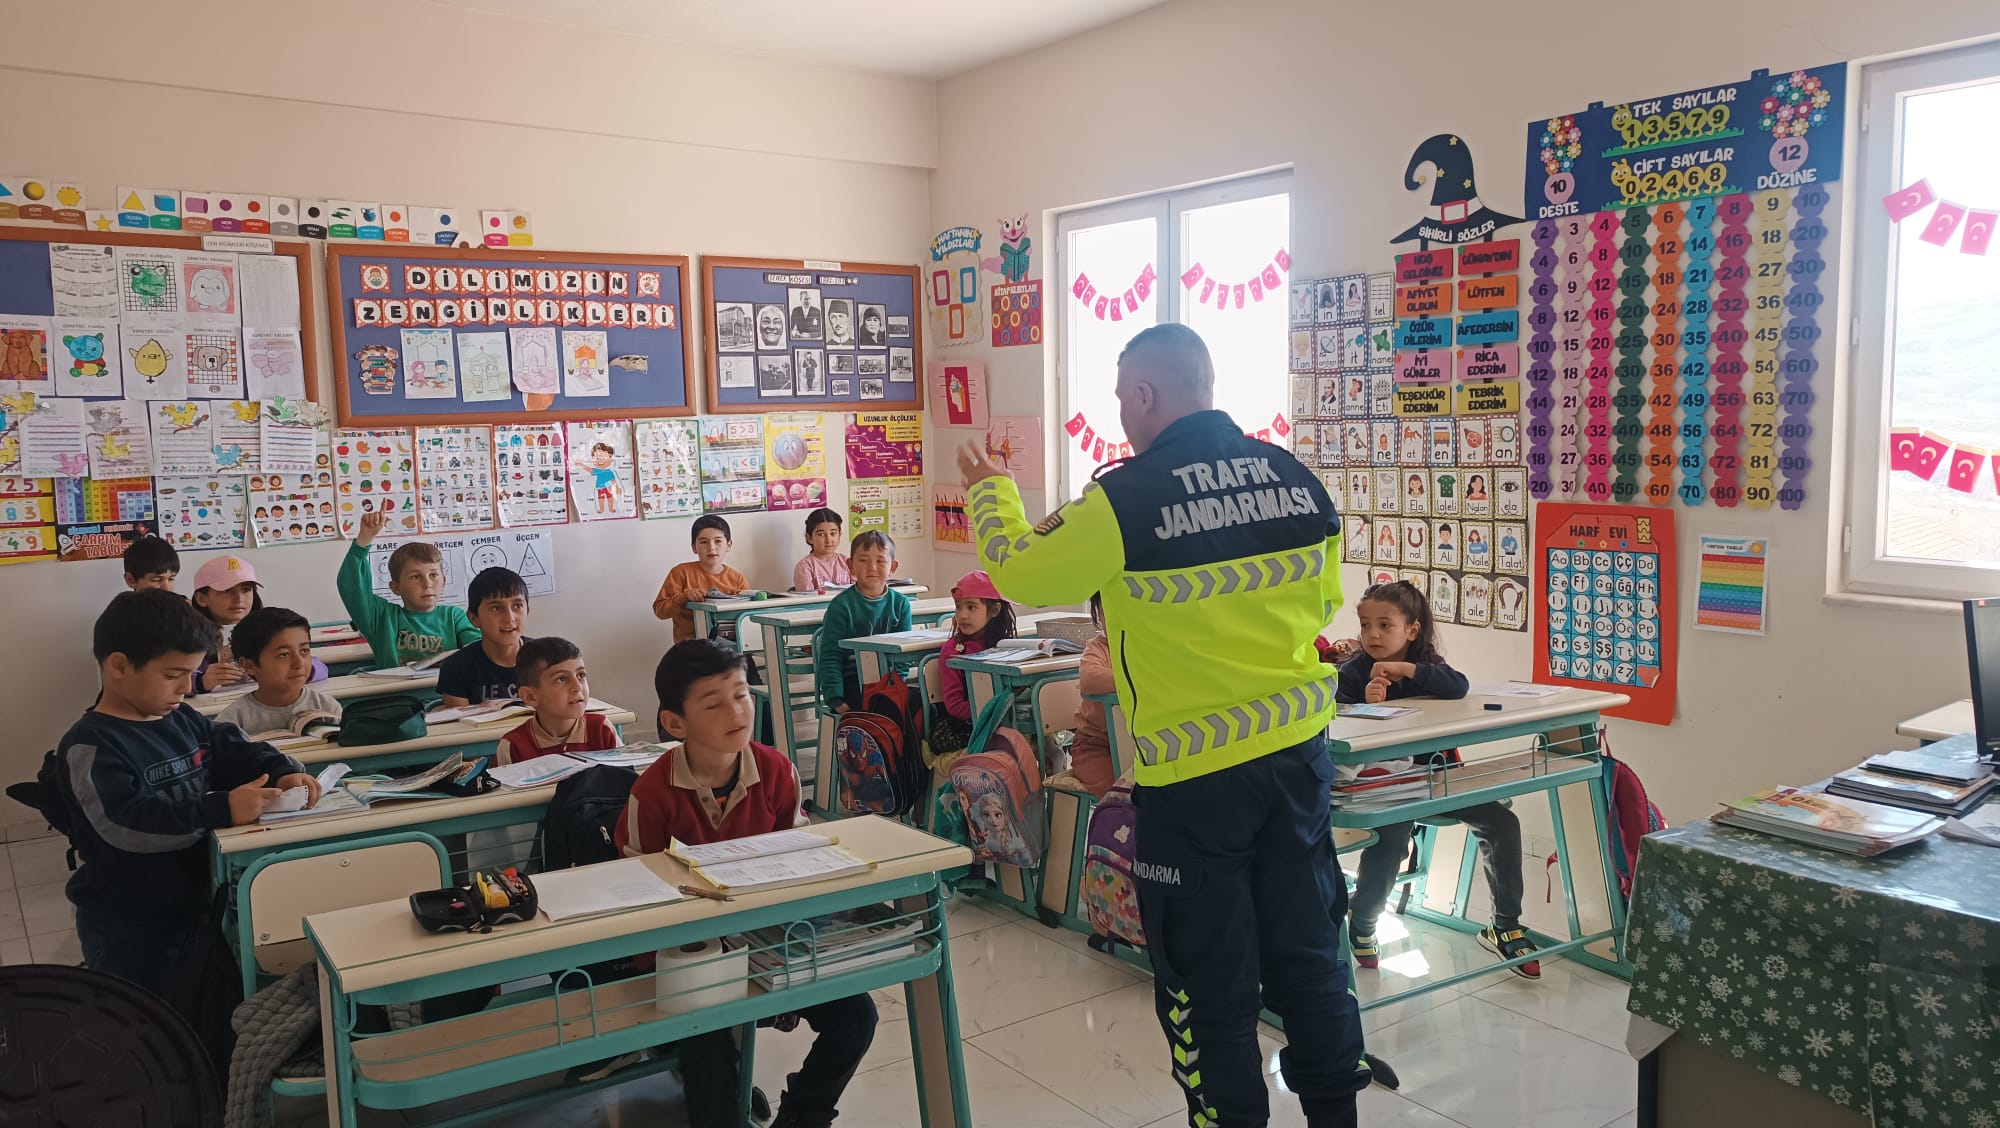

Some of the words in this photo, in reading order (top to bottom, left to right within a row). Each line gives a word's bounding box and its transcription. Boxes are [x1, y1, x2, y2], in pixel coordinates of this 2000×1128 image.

[1633, 101, 1661, 117] TEK
[1672, 88, 1737, 110] SAYILAR
[1627, 124, 1635, 137] 1
[1648, 120, 1658, 134] 3
[1669, 116, 1680, 130] 5
[1692, 113, 1702, 127] 7
[1713, 109, 1724, 124] 9
[1778, 144, 1801, 162] 12
[1633, 157, 1666, 178] ÇİFT
[1671, 148, 1734, 169] SAYILAR
[1626, 181, 1636, 194] 0
[1646, 177, 1656, 192] 2
[1667, 175, 1678, 188] 4
[1689, 171, 1698, 185] 6
[1710, 168, 1721, 182] 8
[1757, 168, 1817, 190] DÜZİNE
[1550, 180, 1567, 194] 10
[1539, 201, 1579, 218] DESTE
[1540, 227, 1548, 239] 2
[1570, 223, 1578, 235] 3
[1600, 219, 1609, 231] 4
[1631, 215, 1640, 227] 5
[1664, 211, 1673, 223] 6
[1696, 205, 1706, 219] 7
[1729, 202, 1740, 215] 8
[1767, 198, 1779, 211] 9
[1803, 193, 1820, 207] 10
[1418, 226, 1452, 242] SİHİRLİ
[1457, 220, 1495, 241] SÖZLER
[412, 269, 623, 290] DİLİMİZİN
[1407, 287, 1439, 299] AFİYET
[1468, 286, 1505, 298] LÜTFEN
[363, 302, 668, 322] ZENGİNLİKLERİ
[1375, 303, 1385, 316] tel
[1407, 301, 1438, 312] OLSUN
[1538, 313, 1546, 324] 8
[1563, 310, 1579, 322] 12
[1593, 308, 1608, 320] 16
[1622, 305, 1643, 318] 20
[1657, 303, 1676, 316] 24
[1686, 300, 1707, 314] 28
[1720, 298, 1742, 311] 32
[1756, 295, 1780, 309] 36
[1790, 293, 1816, 306] 40
[1323, 310, 1333, 320] in
[1409, 321, 1434, 333] ÖZÜR
[1458, 320, 1513, 336] AFEDERSİN
[1404, 334, 1442, 345] DİLERİM
[1351, 351, 1358, 364] it
[1475, 351, 1499, 362] RİCA
[1404, 367, 1440, 378] GÜNLER
[1468, 363, 1506, 376] EDERİM
[1532, 369, 1548, 381] 12
[1563, 368, 1578, 379] 18
[1591, 367, 1608, 379] 24
[1621, 365, 1640, 377] 30
[1654, 364, 1673, 376] 36
[1683, 363, 1704, 376] 42
[1717, 362, 1740, 375] 48
[1755, 360, 1774, 374] 54
[1786, 359, 1810, 373] 60
[1397, 388, 1445, 402] TEŞEKKÜR
[1468, 385, 1504, 398] TEBRİK
[1298, 403, 1305, 414] el
[1320, 404, 1337, 415] Ata
[1346, 403, 1364, 412] anne
[1376, 400, 1389, 412] Eti
[1403, 402, 1438, 413] EDERİM
[1468, 397, 1506, 411] EDERİM
[864, 415, 888, 423] UZUNLUK
[890, 414, 917, 424] ÖLÇÜLERİ
[1323, 452, 1340, 460] nine
[1377, 451, 1391, 460] ne
[1407, 450, 1416, 458] at
[1435, 451, 1449, 460] en
[1467, 451, 1476, 460] et
[1495, 449, 1512, 459] an
[1172, 457, 1280, 495] TRAFİK
[5, 479, 17, 491] 2
[24, 478, 33, 491] 5
[1381, 497, 1394, 510] ele
[1410, 500, 1423, 511] Ela
[1436, 499, 1457, 511] laleli
[1467, 502, 1488, 512] Nalan
[1504, 500, 1517, 511] ela
[6, 507, 17, 520] 8
[25, 506, 37, 520] 3
[1154, 487, 1319, 540] JANDARMASI
[516, 533, 540, 542] ÜÇGEN
[1570, 526, 1600, 538] HARF
[1609, 525, 1627, 539] EVİ
[8, 537, 19, 550] 4
[26, 536, 37, 550] 9
[72, 533, 122, 551] ÇARPIM
[471, 535, 501, 546] ÇEMBER
[376, 543, 398, 551] KARE
[1350, 548, 1367, 558] atlet
[1381, 548, 1392, 559] Nil
[1409, 549, 1421, 559] nal
[1551, 554, 1567, 565] Aa
[1466, 556, 1489, 567] Naile
[1498, 556, 1522, 568] Talat
[1573, 555, 1590, 566] Bb
[1595, 557, 1609, 567] Cc
[1616, 556, 1632, 569] Çç
[1638, 559, 1653, 570] Dd
[1574, 576, 1585, 589] Ff
[1596, 579, 1612, 591] Gg
[1618, 580, 1631, 595] Ğğ
[1468, 606, 1484, 617] aile
[1503, 607, 1517, 621] nal
[1596, 621, 1612, 631] Oo
[1639, 624, 1653, 635] Pp
[1596, 641, 1612, 656] Şş
[1575, 661, 1589, 672] Vv
[1596, 665, 1609, 676] Yy
[481, 685, 498, 701] LE
